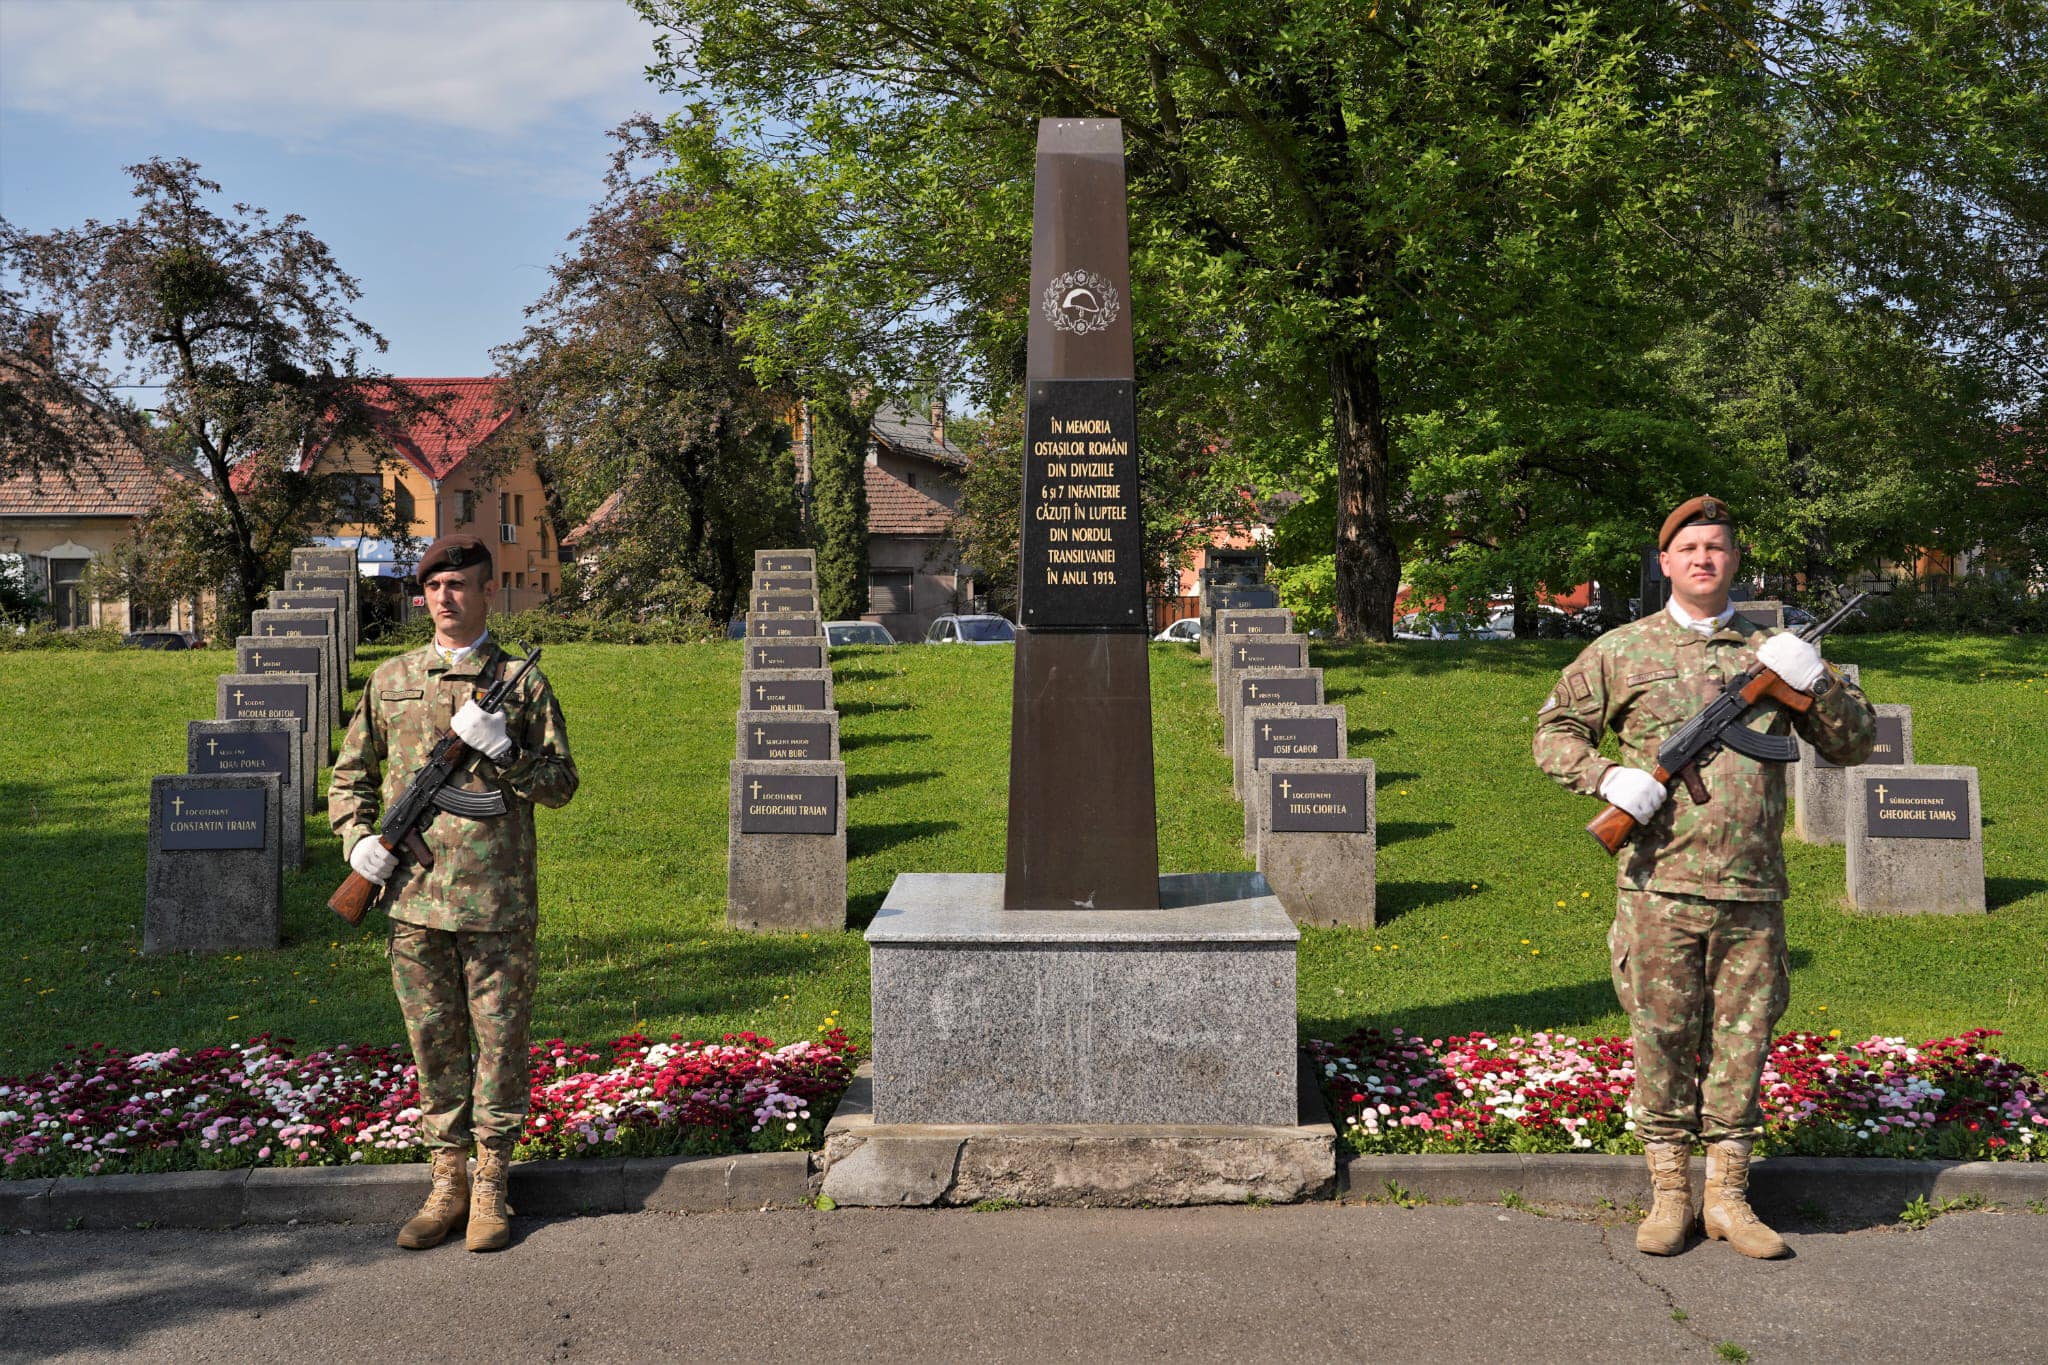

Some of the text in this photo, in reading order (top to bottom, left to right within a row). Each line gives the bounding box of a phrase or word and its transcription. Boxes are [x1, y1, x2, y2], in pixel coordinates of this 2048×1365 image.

[1051, 415, 1111, 434] ÎN MEMORIA
[1088, 437, 1128, 456] ROMÂNI
[1047, 463, 1114, 477] DIN DIVIZIILE
[1042, 485, 1048, 499] 6
[1058, 485, 1065, 499] 7
[1068, 485, 1121, 499] INFANTERIE
[1036, 502, 1127, 524] CĂZUȚI ÎN LUPTELE
[1049, 528, 1113, 542] DIN NORDUL
[1047, 549, 1116, 564] TRANSILVANIEI
[1046, 567, 1117, 585] ÎN ANUL 1919.
[769, 749, 787, 758] IOAN
[1274, 745, 1292, 754] IOSIF
[749, 805, 828, 816] GHEORGHIU TRAIAN
[1290, 804, 1347, 814] TITUS CIORTEA
[1880, 809, 1927, 820] GHEORGHE
[170, 820, 257, 832] CONSTANTIN TRAIAN
